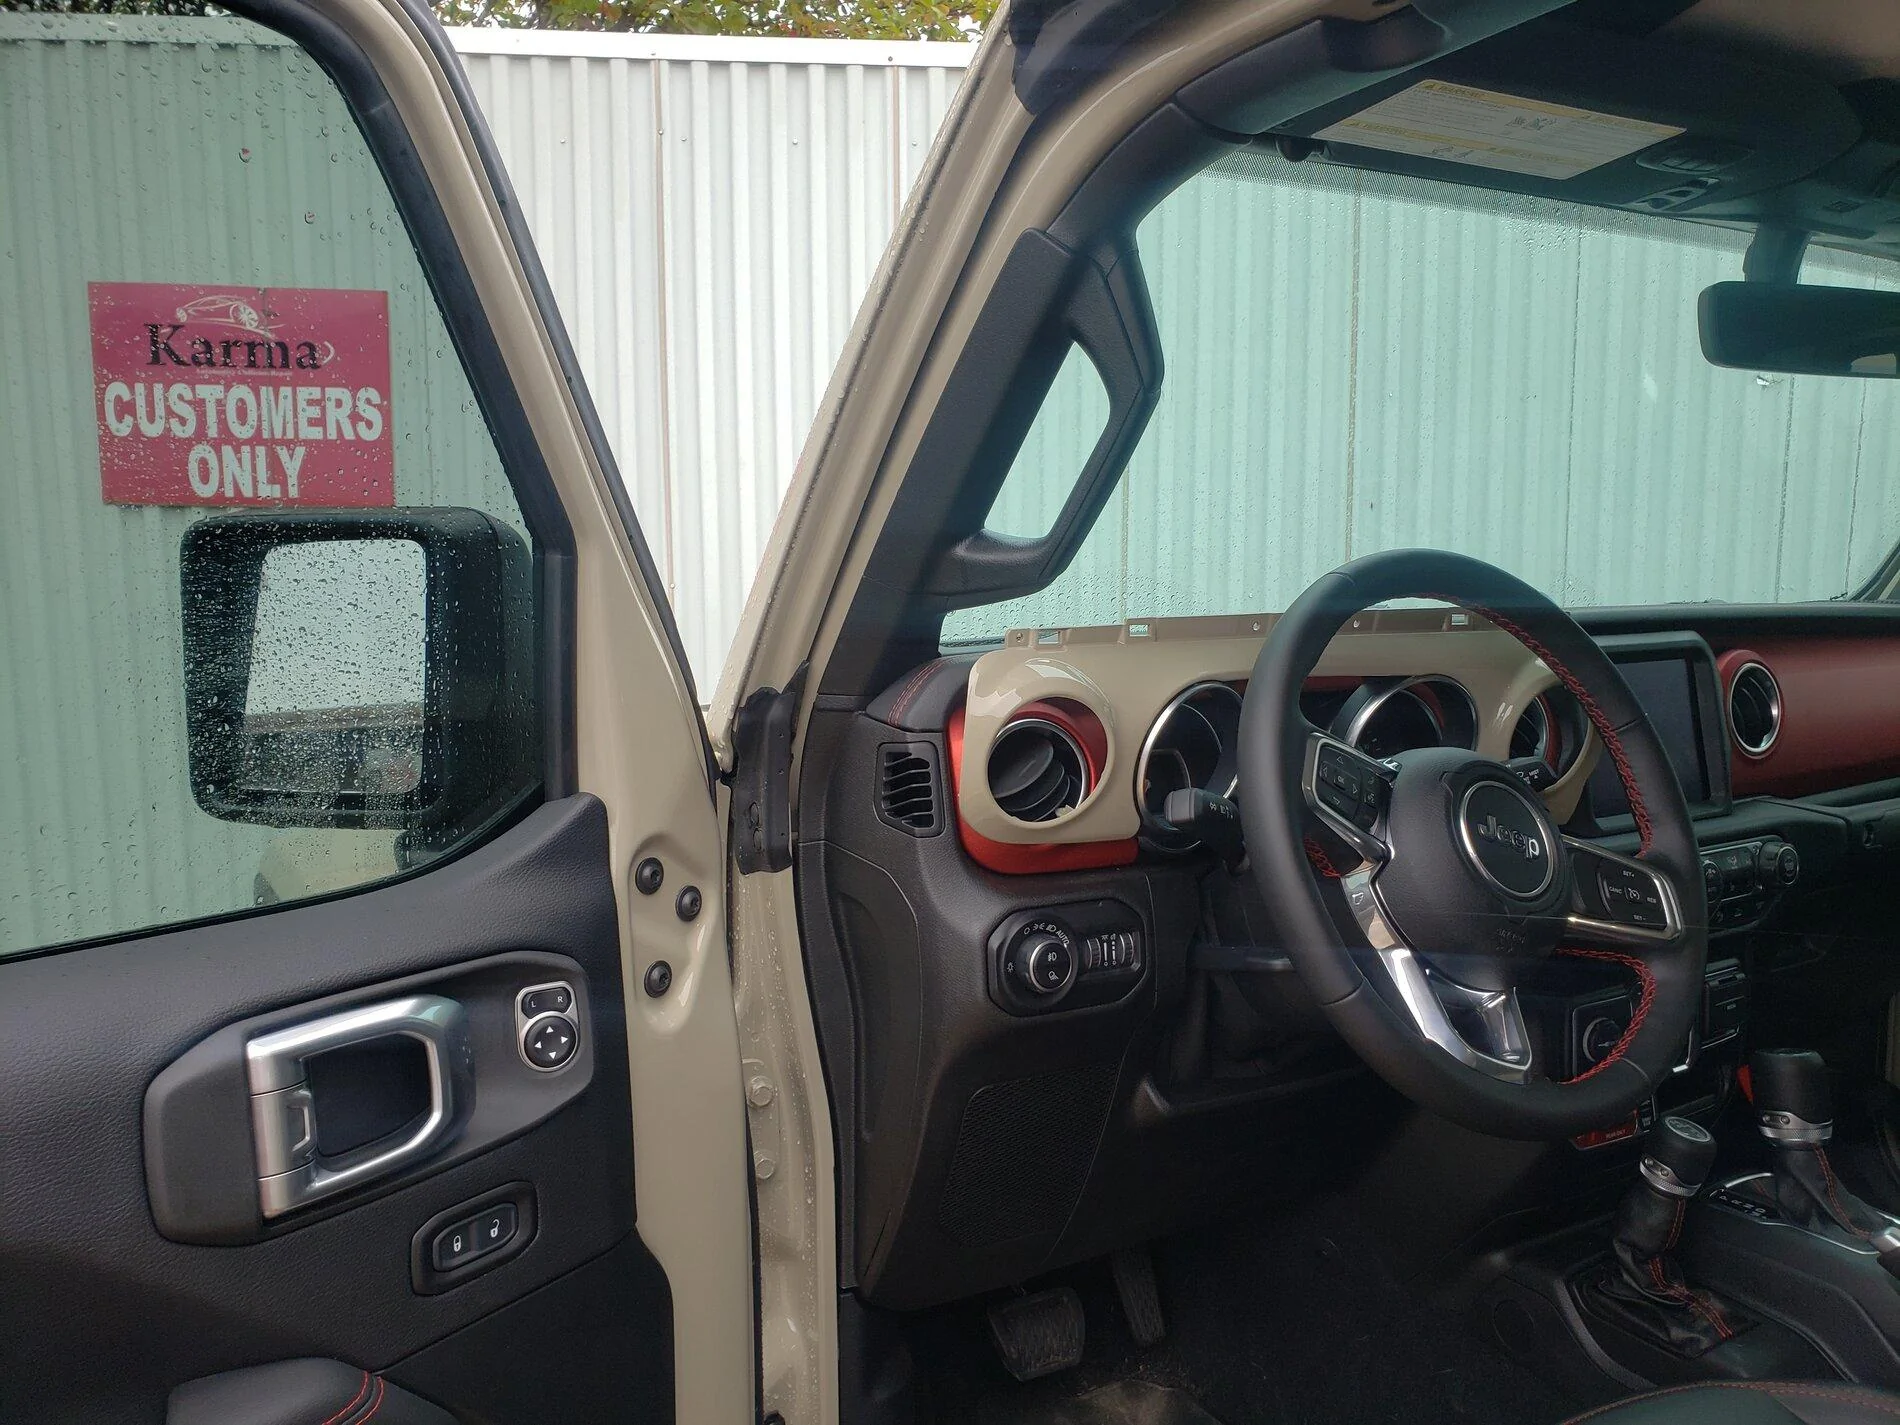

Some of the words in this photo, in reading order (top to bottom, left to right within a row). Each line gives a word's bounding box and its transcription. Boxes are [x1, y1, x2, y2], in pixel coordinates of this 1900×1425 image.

[144, 323, 321, 370] Karma
[104, 382, 383, 441] CUSTOMERS
[187, 444, 306, 498] ONLY
[1477, 815, 1540, 859] Jeep
[1055, 929, 1070, 945] AUTO
